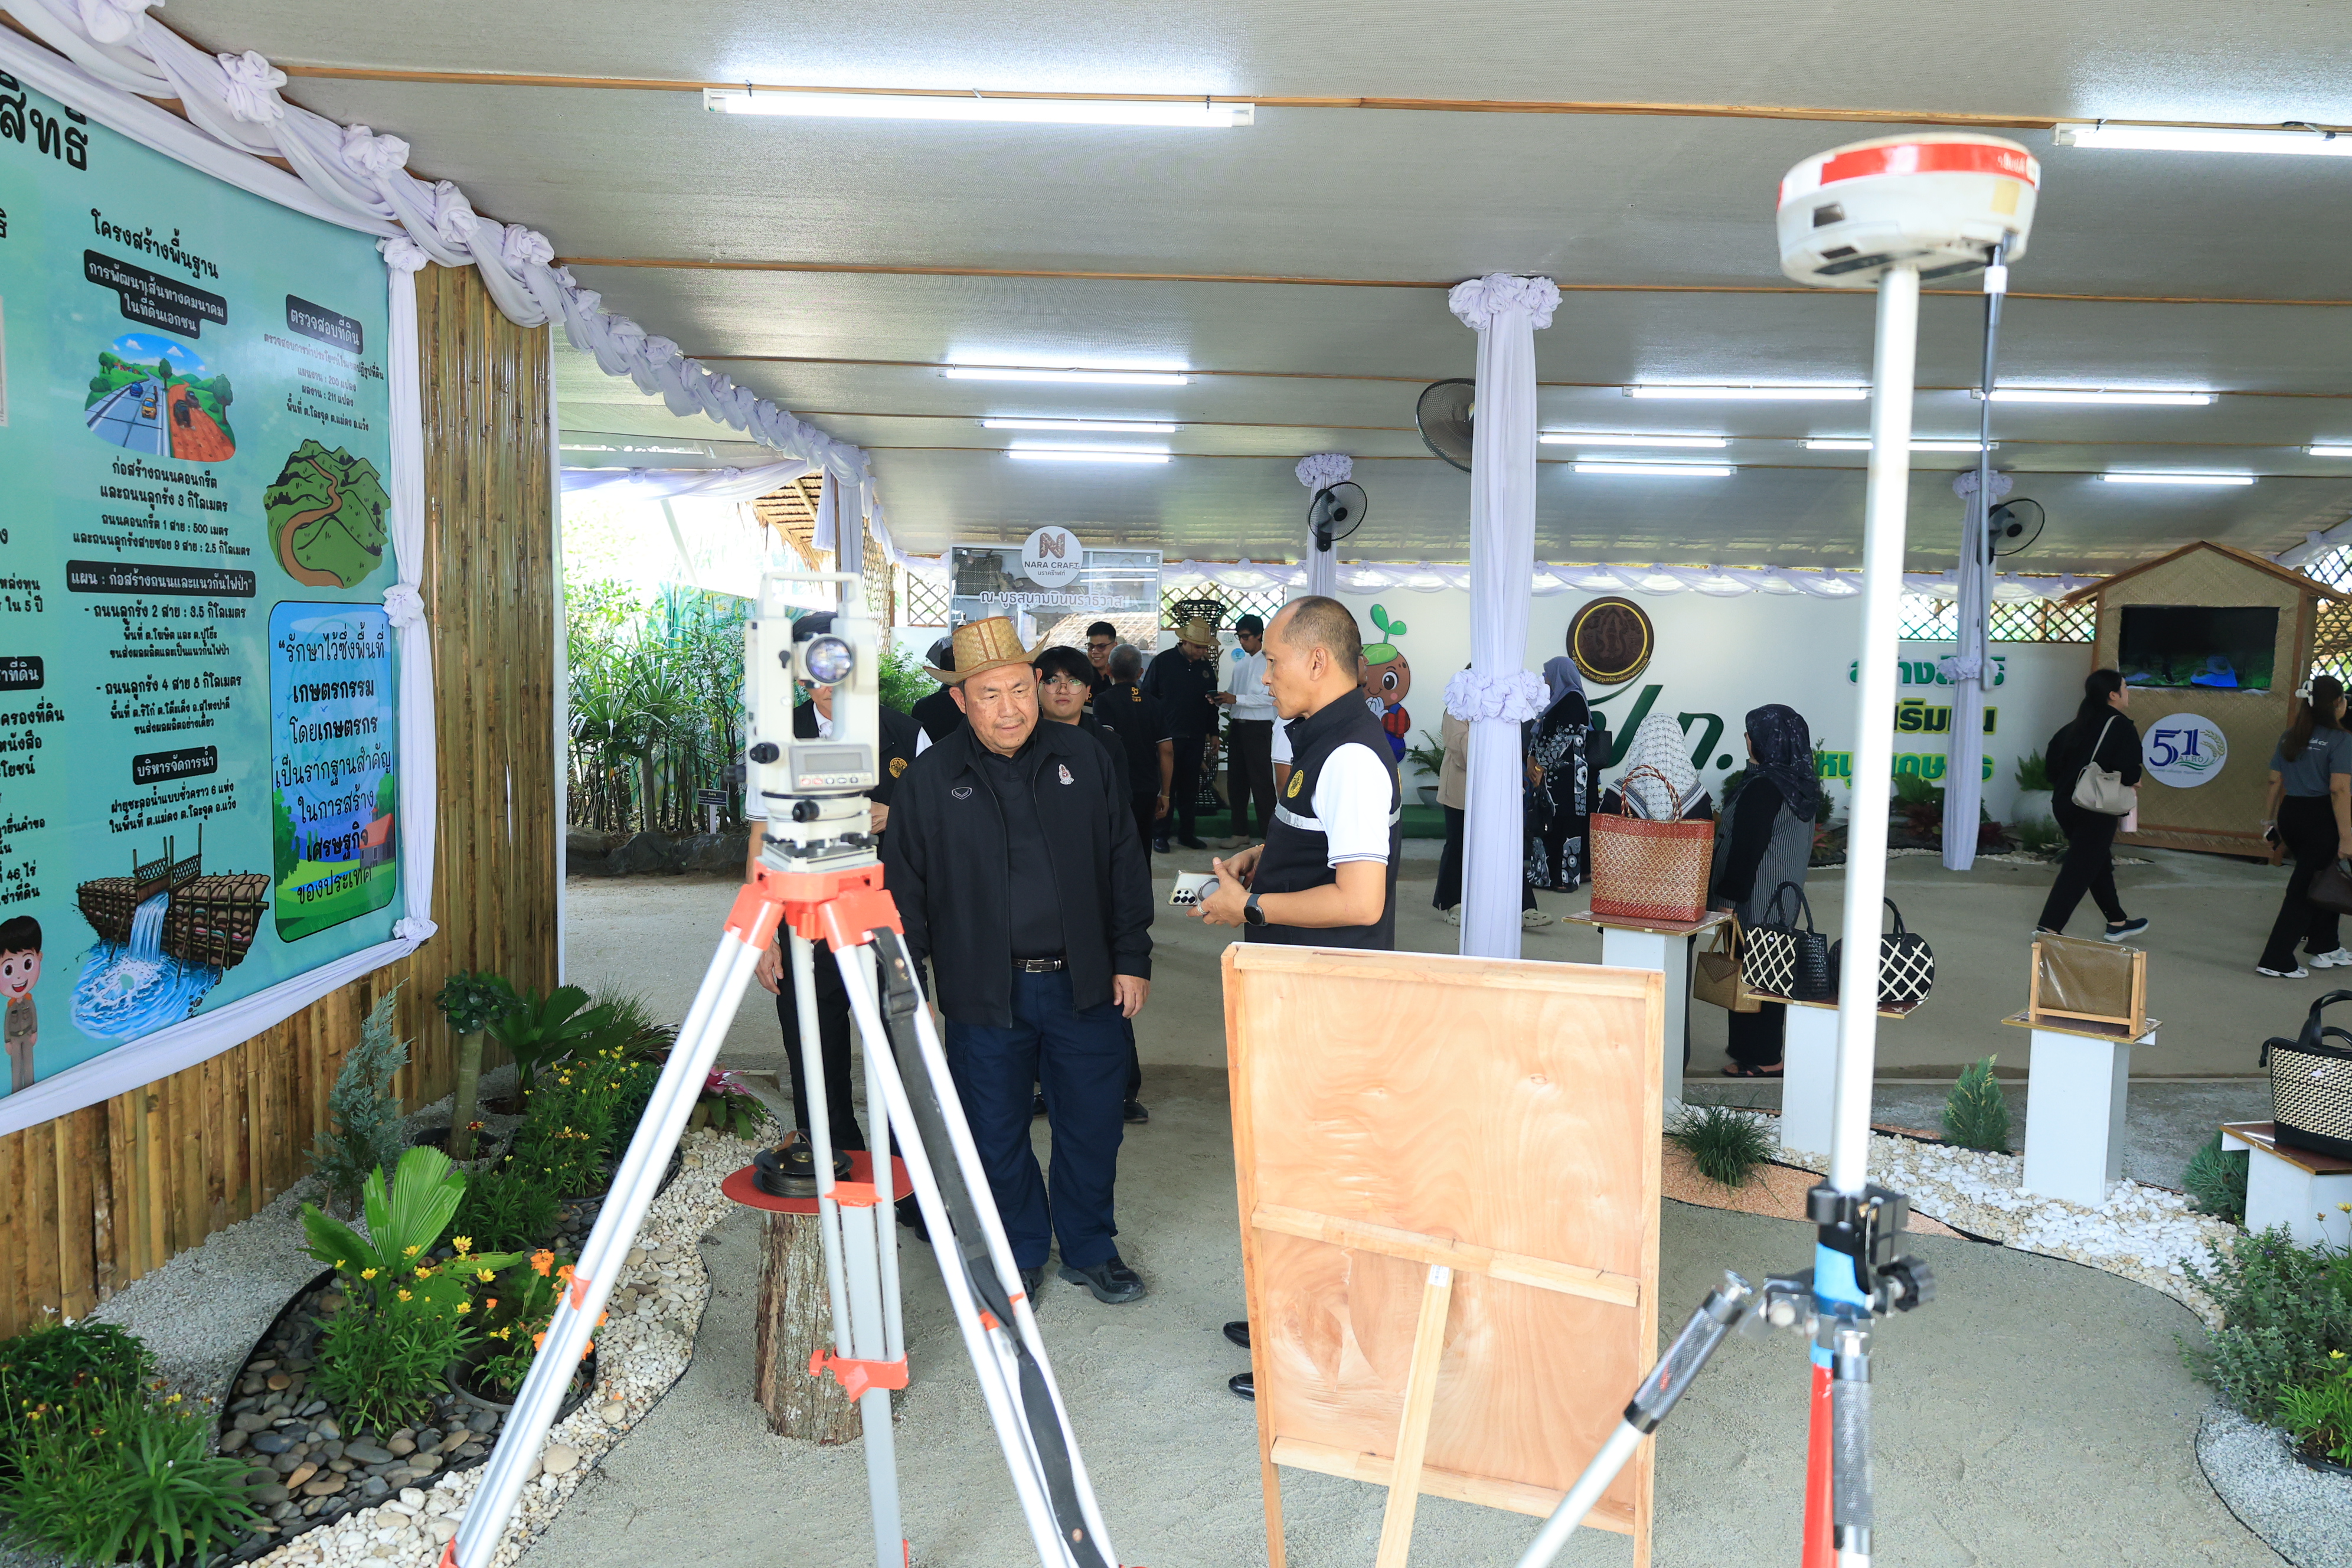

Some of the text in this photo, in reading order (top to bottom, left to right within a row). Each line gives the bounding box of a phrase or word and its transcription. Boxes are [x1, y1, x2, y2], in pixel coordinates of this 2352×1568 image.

[91, 208, 219, 279] โครงสร้างพื้นฐาน
[89, 262, 224, 318] การพัฒนาเส้นทางคมนาคม
[290, 308, 360, 347] ตรวจสอบที่ดิน
[298, 367, 324, 383] แผนงาน
[341, 379, 357, 392] แปลง
[286, 393, 302, 414] พื้นที่
[302, 384, 322, 399] ผลงาน
[328, 391, 337, 403] 211
[338, 394, 354, 407] แปลง
[112, 456, 217, 489] ก่อสร้างถนนคอนกรีต
[100, 485, 228, 512] และถนนลูกรัง 3 กิโลเมตร
[102, 513, 160, 530] ถนนคอนกรีต
[170, 520, 185, 532] สาย
[193, 523, 207, 534] 500
[210, 526, 228, 537] เมตร
[73, 532, 172, 552] และถนนลูกรังสายซอย
[174, 540, 179, 550] 9
[182, 540, 197, 553] สาย
[205, 542, 217, 554] 2.5
[218, 540, 250, 556] กิโลเมตร
[71, 571, 98, 585] แผน
[5, 595, 21, 612] ใน
[25, 600, 31, 612] 5
[34, 594, 43, 613] ปี
[93, 599, 148, 623] ถนนลูกรัง
[152, 605, 158, 618] 2
[161, 604, 180, 618] สาย
[190, 605, 204, 618] 3.5
[207, 601, 246, 619] กิโลเมตร
[177, 631, 191, 639] และ
[0, 655, 40, 682] าที่ดิน
[104, 674, 159, 701] ถนนลูกรัง
[162, 679, 168, 691] 4
[172, 678, 190, 691] สาย
[194, 677, 200, 689] 8
[202, 671, 241, 689] กิโลเมตร
[293, 680, 374, 703] เกษตรกรรม
[110, 700, 130, 719] พื้นที่
[289, 716, 378, 744] โดยเกษตรกร
[2149, 729, 2201, 766] 51
[0, 754, 35, 778] โยชน์
[136, 746, 214, 778] บริหารจัดการน้ำ
[276, 742, 391, 788] เป็นรากฐานสำคัญ
[211, 785, 216, 795] 6
[218, 778, 234, 794] แห่ง
[298, 783, 375, 824] ในการสร้าง
[109, 809, 143, 834] ในพื้นที่
[306, 821, 369, 863] เศรษฐกิจ
[6, 868, 21, 881] 46
[22, 860, 37, 878] ไร่
[0, 878, 41, 906] ช่าที่ดิน
